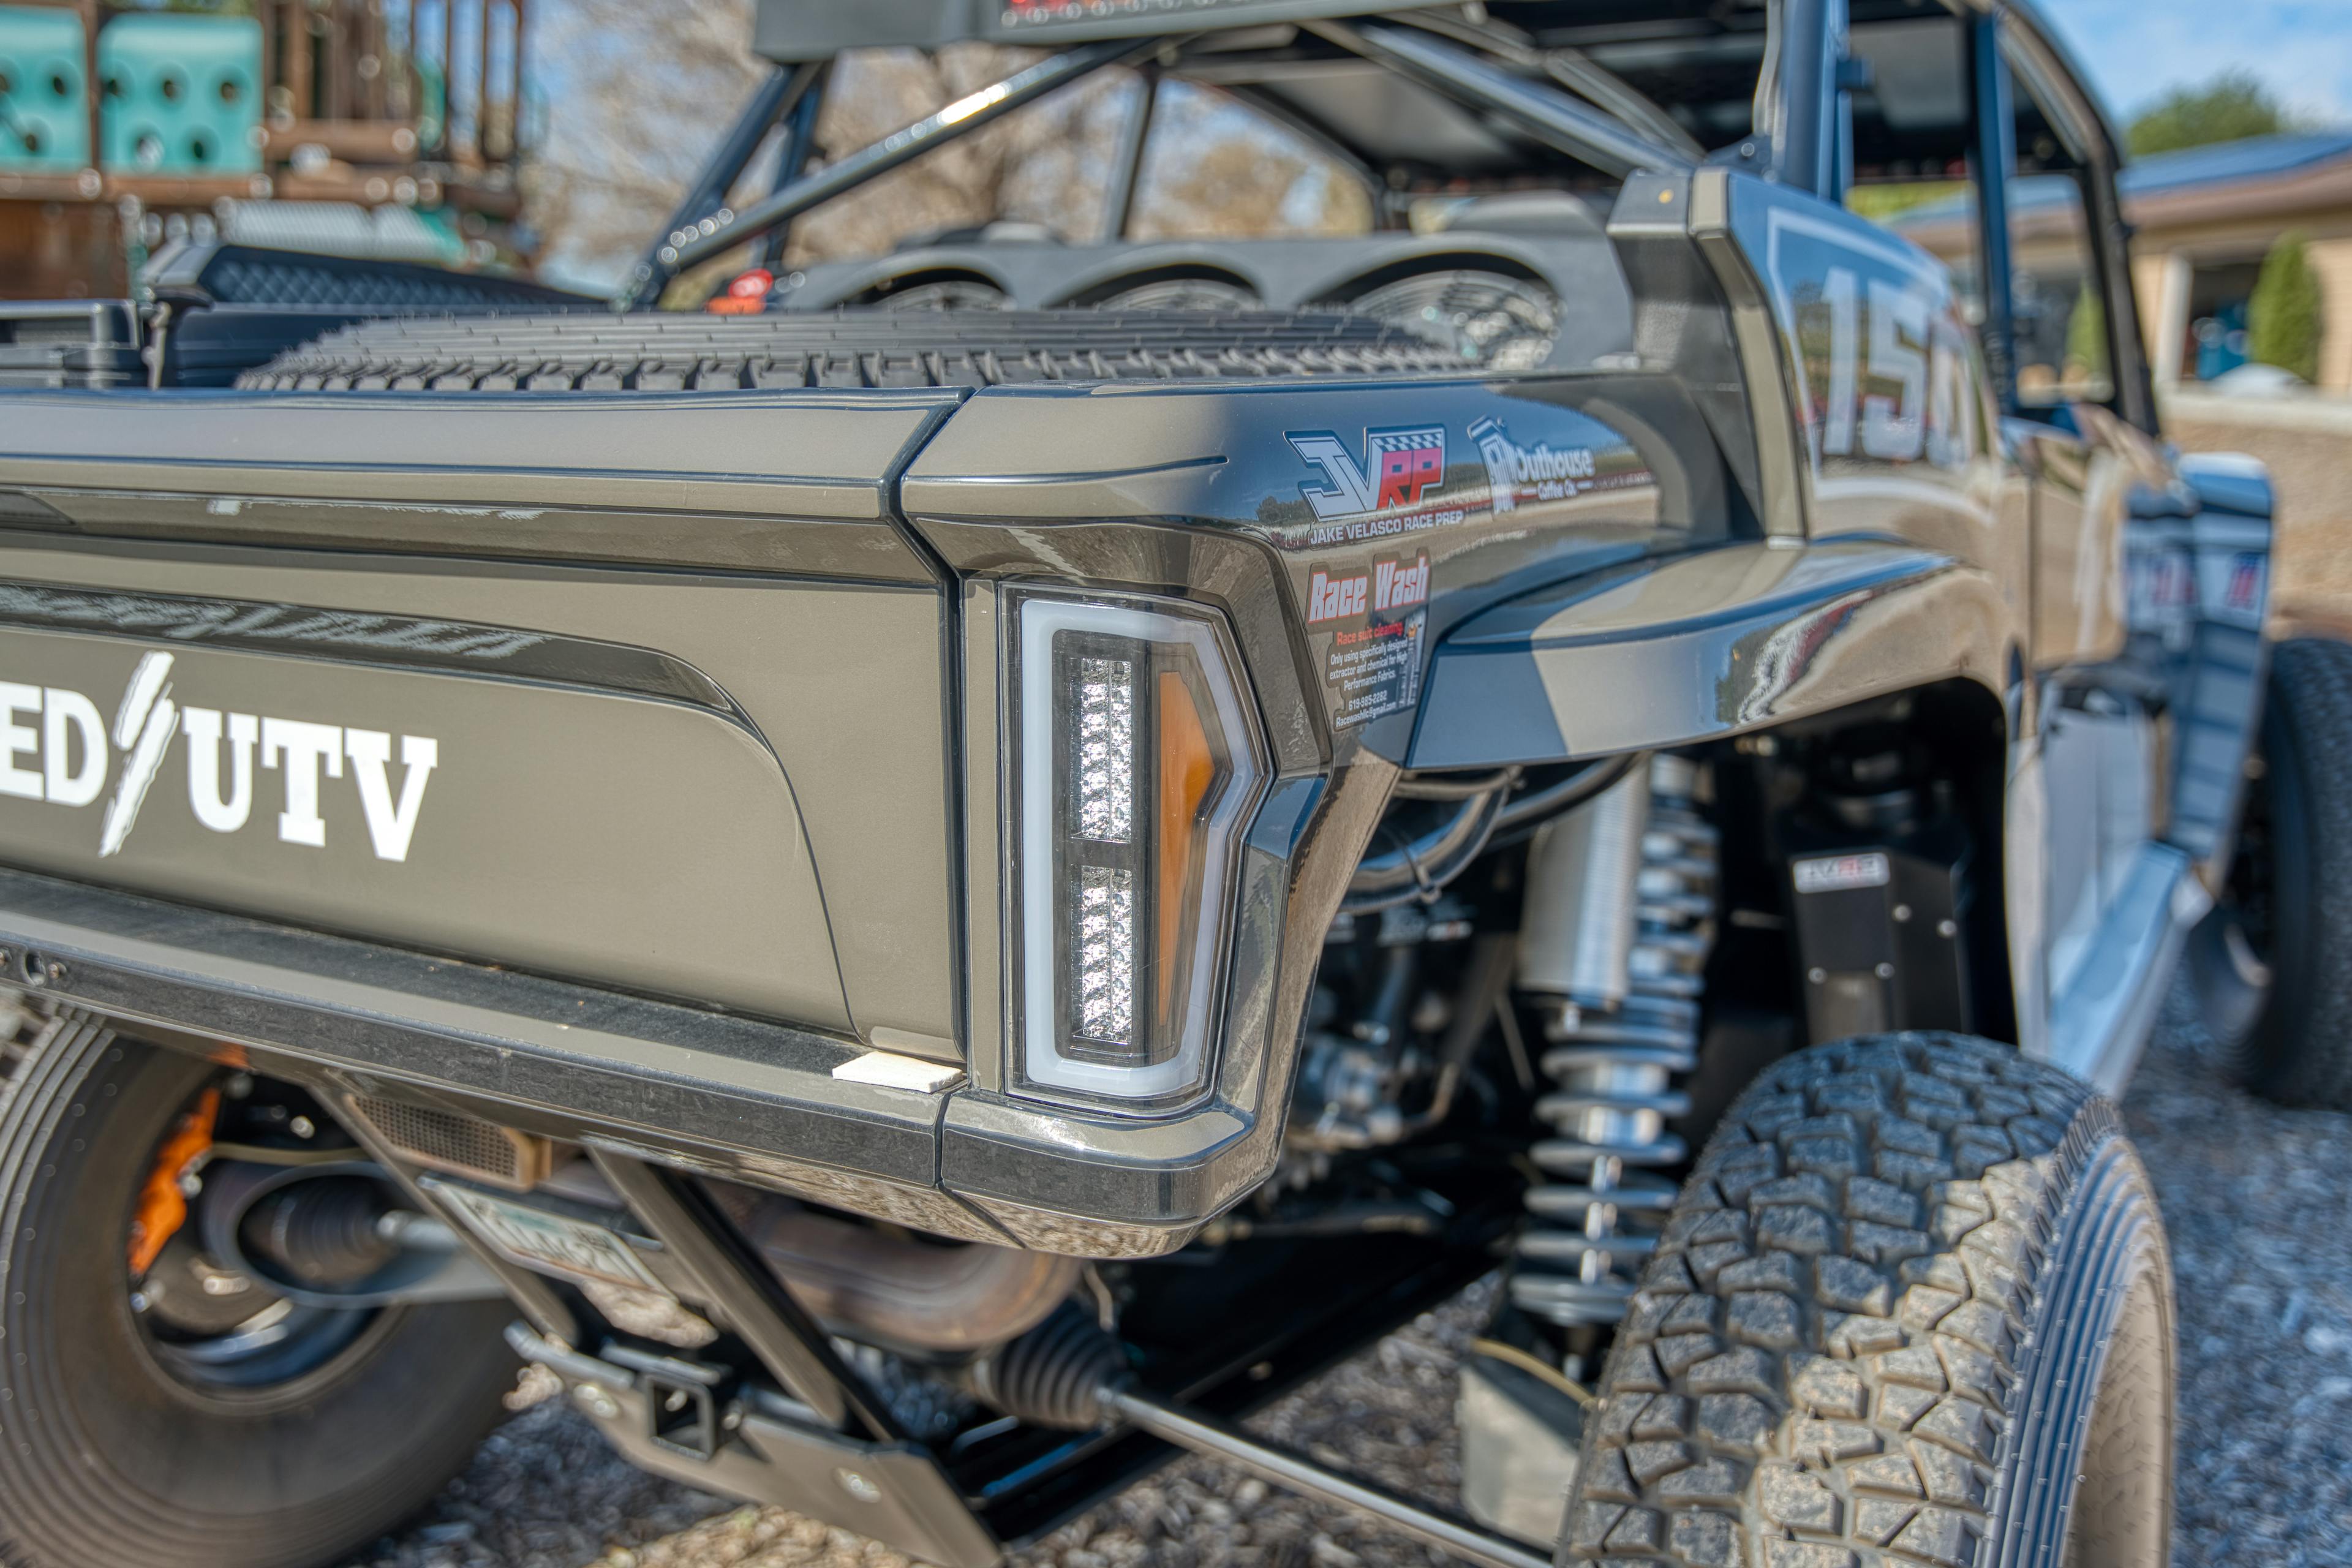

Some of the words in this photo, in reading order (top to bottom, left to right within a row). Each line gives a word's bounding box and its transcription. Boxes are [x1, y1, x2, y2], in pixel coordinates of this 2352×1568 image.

[1288, 428, 1444, 521] JVRP
[1515, 443, 1596, 483] Outhouse
[1538, 480, 1564, 500] Coffee
[1310, 526, 1344, 545] JAKE
[1345, 520, 1402, 540] VELASCO
[1404, 514, 1433, 532] RACE
[1435, 510, 1464, 526] PREP
[1308, 571, 1368, 624] Race
[1374, 556, 1430, 611] Wash
[1330, 654, 1343, 665] Only
[1344, 650, 1359, 663] using
[1359, 642, 1387, 660] specifically
[1387, 637, 1408, 652] designed
[1336, 631, 1357, 646] Race
[1358, 627, 1373, 641] suit
[1330, 666, 1356, 680] extractor
[1357, 662, 1366, 674] and
[1367, 656, 1389, 671] chemical
[1396, 651, 1408, 665] High
[1344, 674, 1377, 691] Performance
